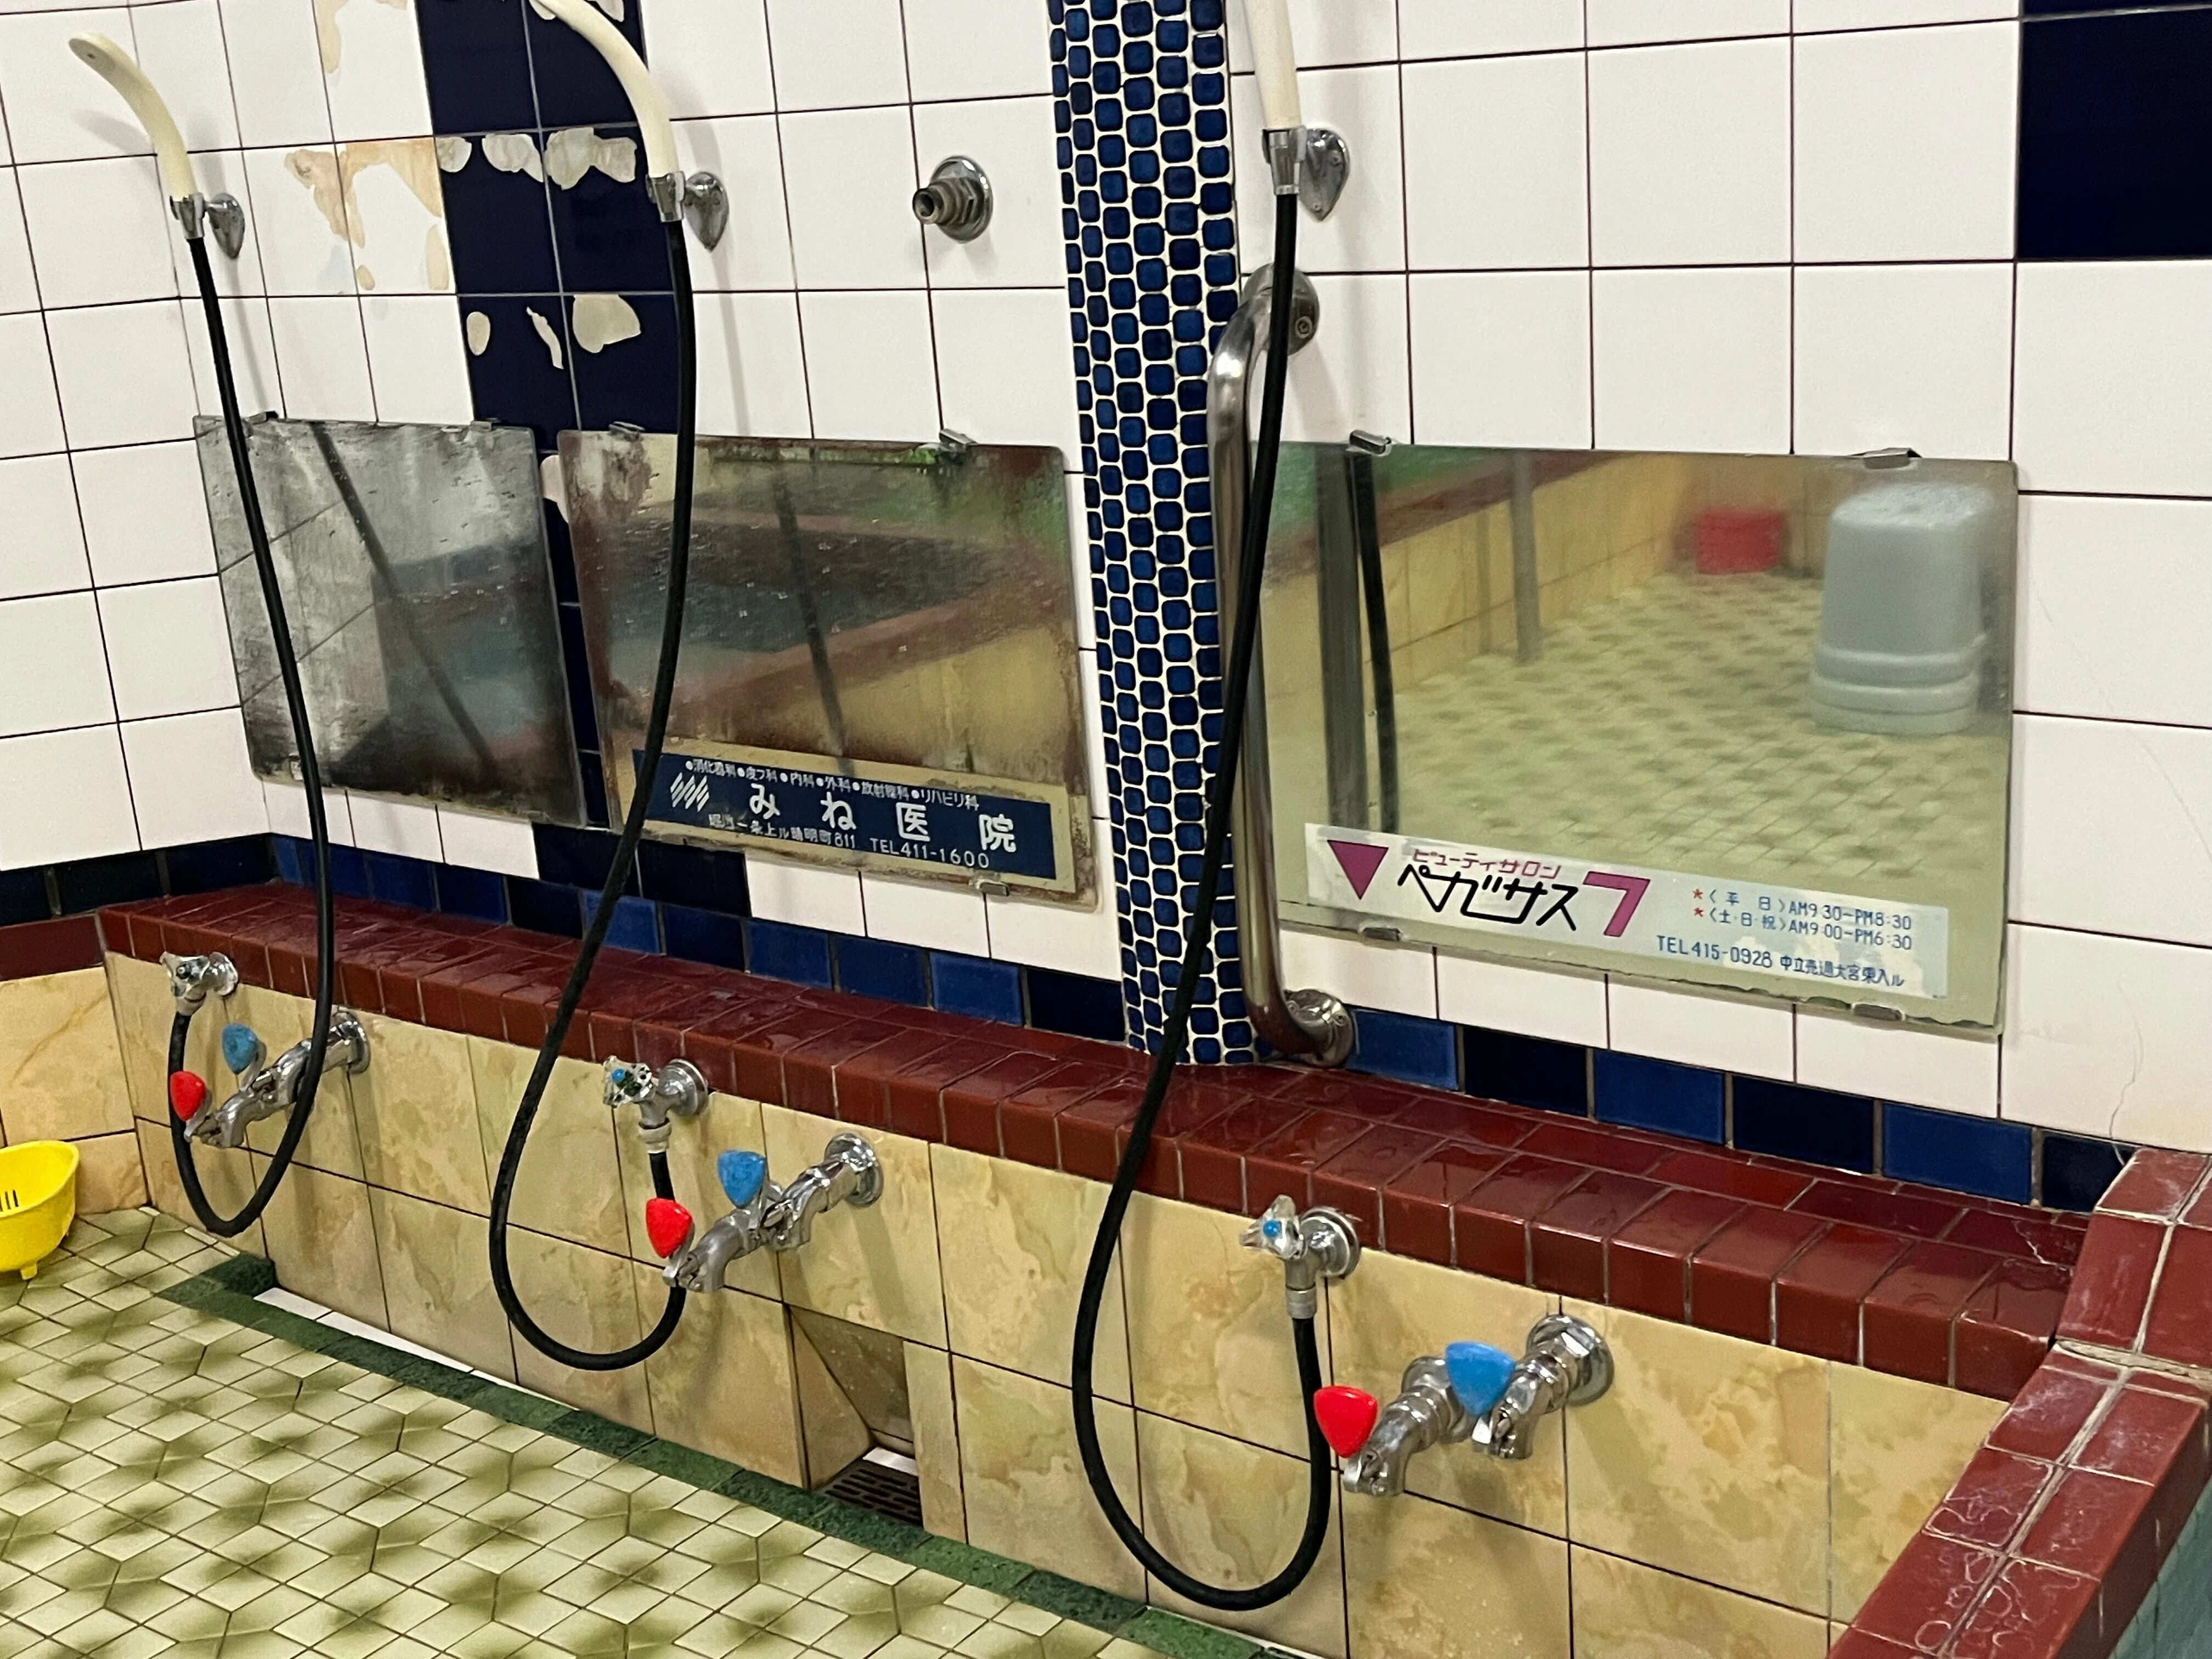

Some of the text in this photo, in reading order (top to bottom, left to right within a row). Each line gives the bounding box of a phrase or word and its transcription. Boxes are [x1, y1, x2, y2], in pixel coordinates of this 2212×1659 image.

[749, 783, 1016, 853] みね医院
[870, 838, 989, 868] TEL411-1600
[1413, 849, 1562, 879] ビューティサロン
[1657, 935, 1772, 968] TEL415-0928
